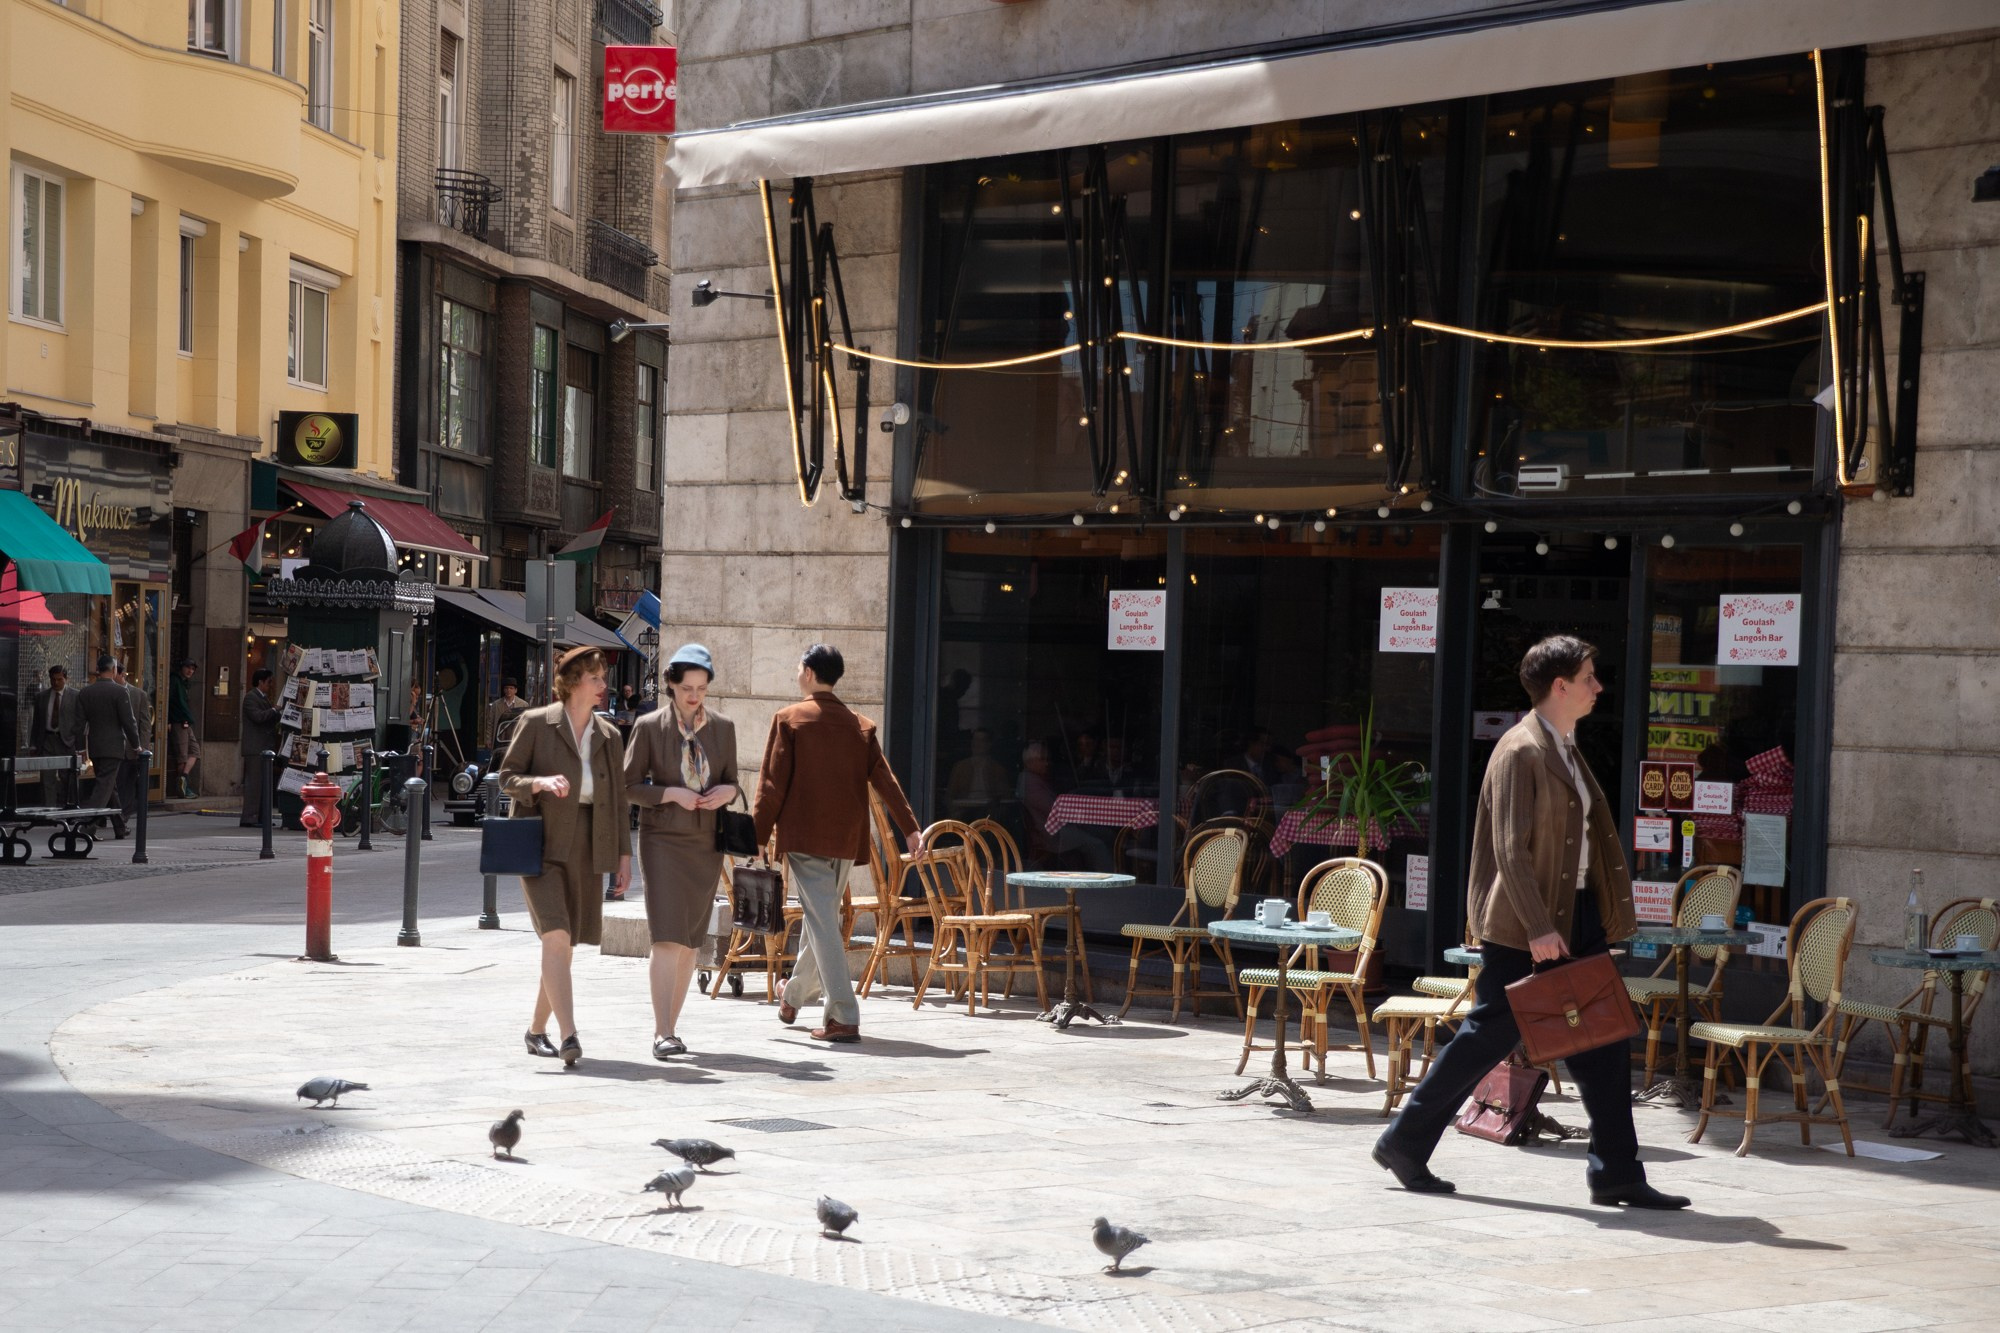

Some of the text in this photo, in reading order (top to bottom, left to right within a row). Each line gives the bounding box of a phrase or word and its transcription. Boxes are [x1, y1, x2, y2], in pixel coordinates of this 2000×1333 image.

[54, 476, 131, 542] Makausz
[1399, 609, 1427, 617] Goulash
[1742, 618, 1775, 626] Goulash
[1119, 623, 1142, 632] Langosh
[1393, 623, 1420, 632] Langosh
[1755, 626, 1761, 634] &
[1734, 634, 1784, 643] Langosh Bar
[1646, 773, 1661, 782] ONLY
[1673, 774, 1688, 783] ONLY
[1645, 782, 1664, 791] CARD!
[1671, 783, 1691, 791] CARD!
[1634, 885, 1659, 894] TILOS A
[1634, 895, 1672, 905] DOHÁNYZÁS
